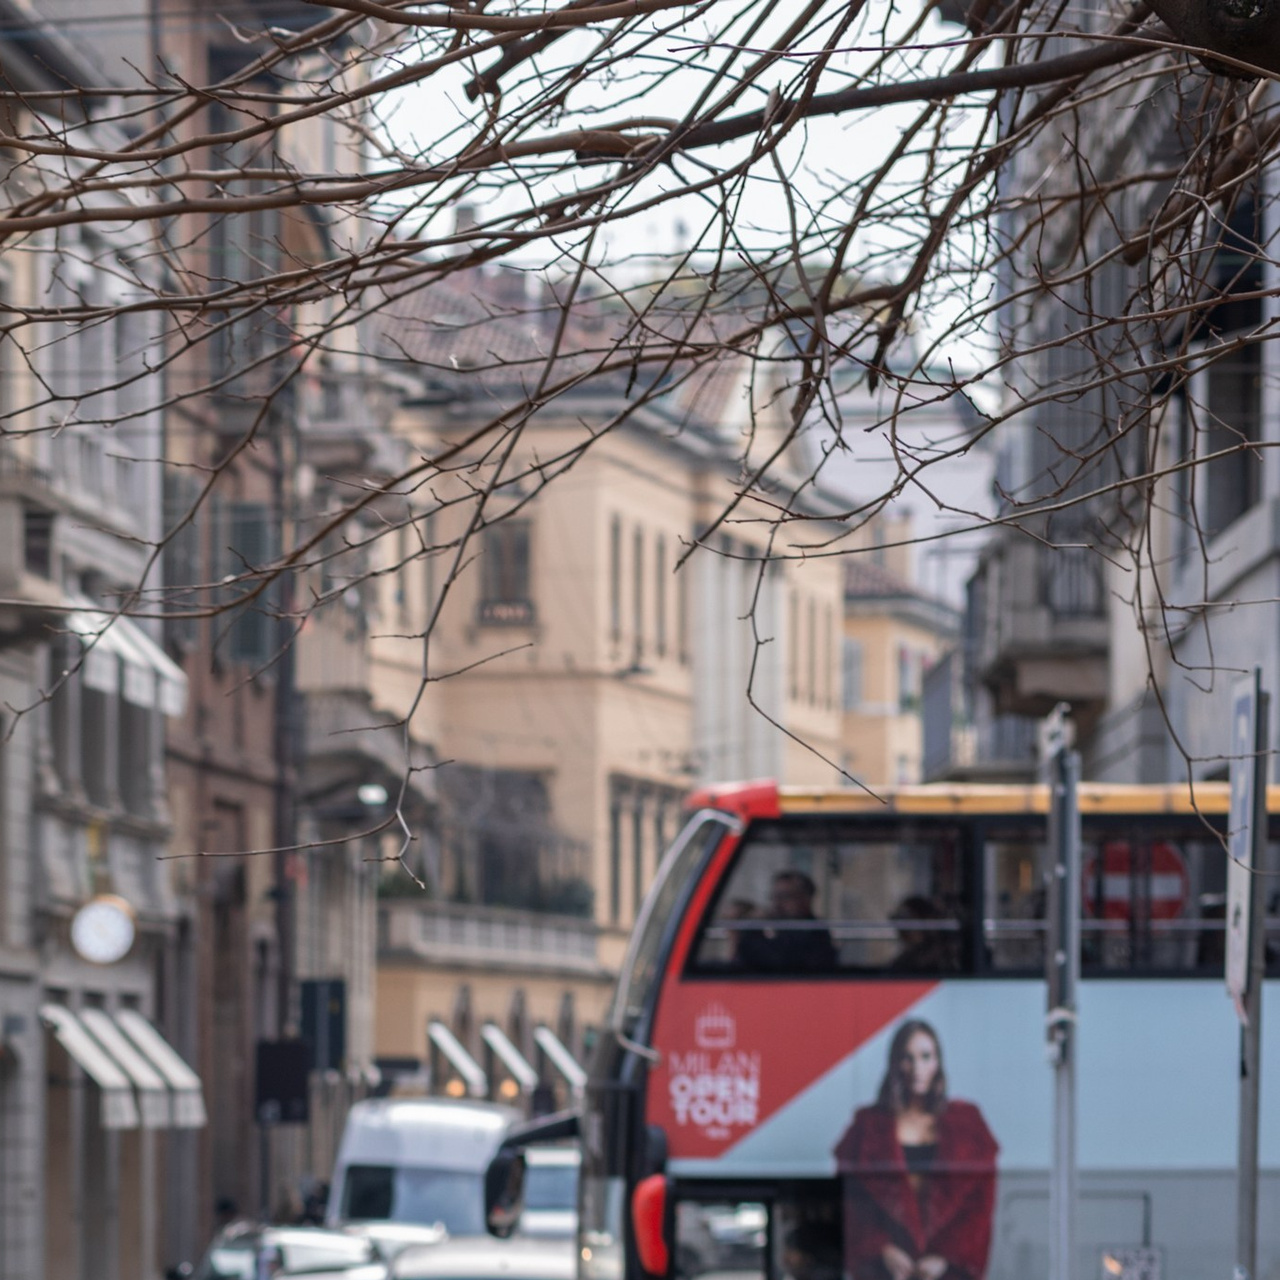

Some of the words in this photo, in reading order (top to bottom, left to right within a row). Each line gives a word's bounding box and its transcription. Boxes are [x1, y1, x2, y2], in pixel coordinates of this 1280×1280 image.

[669, 1051, 761, 1075] MILAN
[669, 1074, 760, 1099] OPEN
[673, 1098, 758, 1126] TOUR
